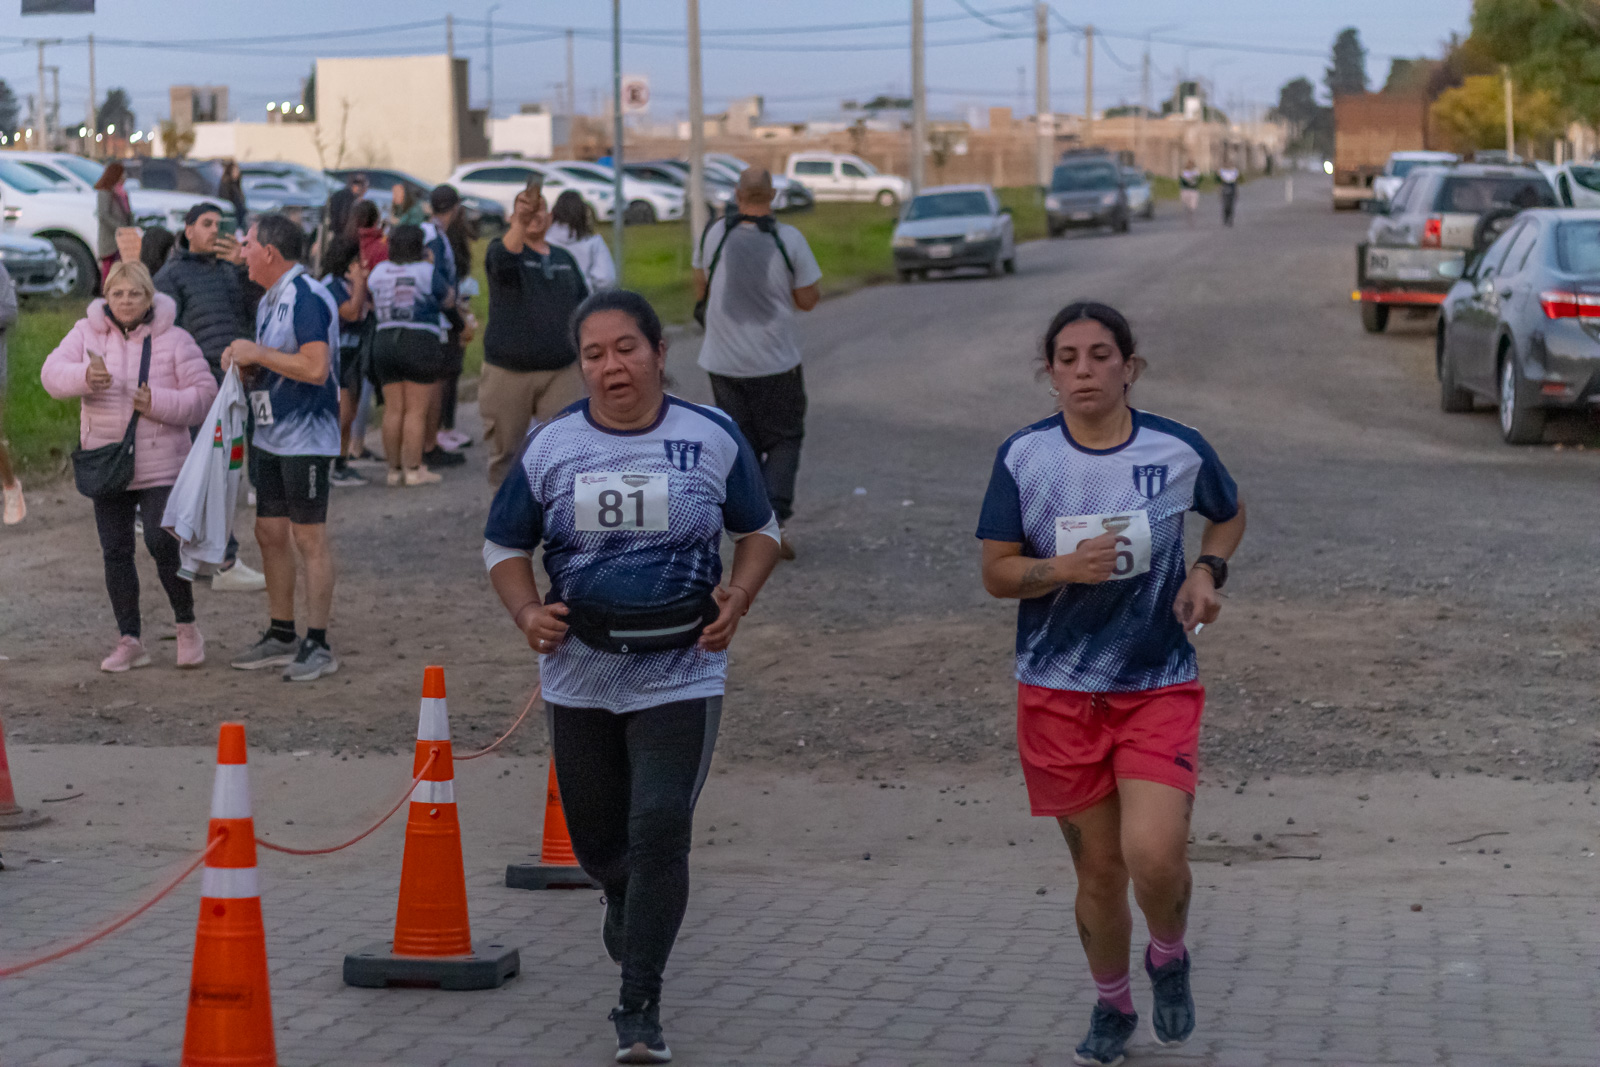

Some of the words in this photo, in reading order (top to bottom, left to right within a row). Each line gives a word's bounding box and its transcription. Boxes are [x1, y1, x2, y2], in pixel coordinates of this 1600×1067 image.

[670, 442, 696, 452] SFC
[1138, 467, 1162, 476] SFC
[598, 489, 644, 528] 81
[1076, 535, 1135, 576] 6
